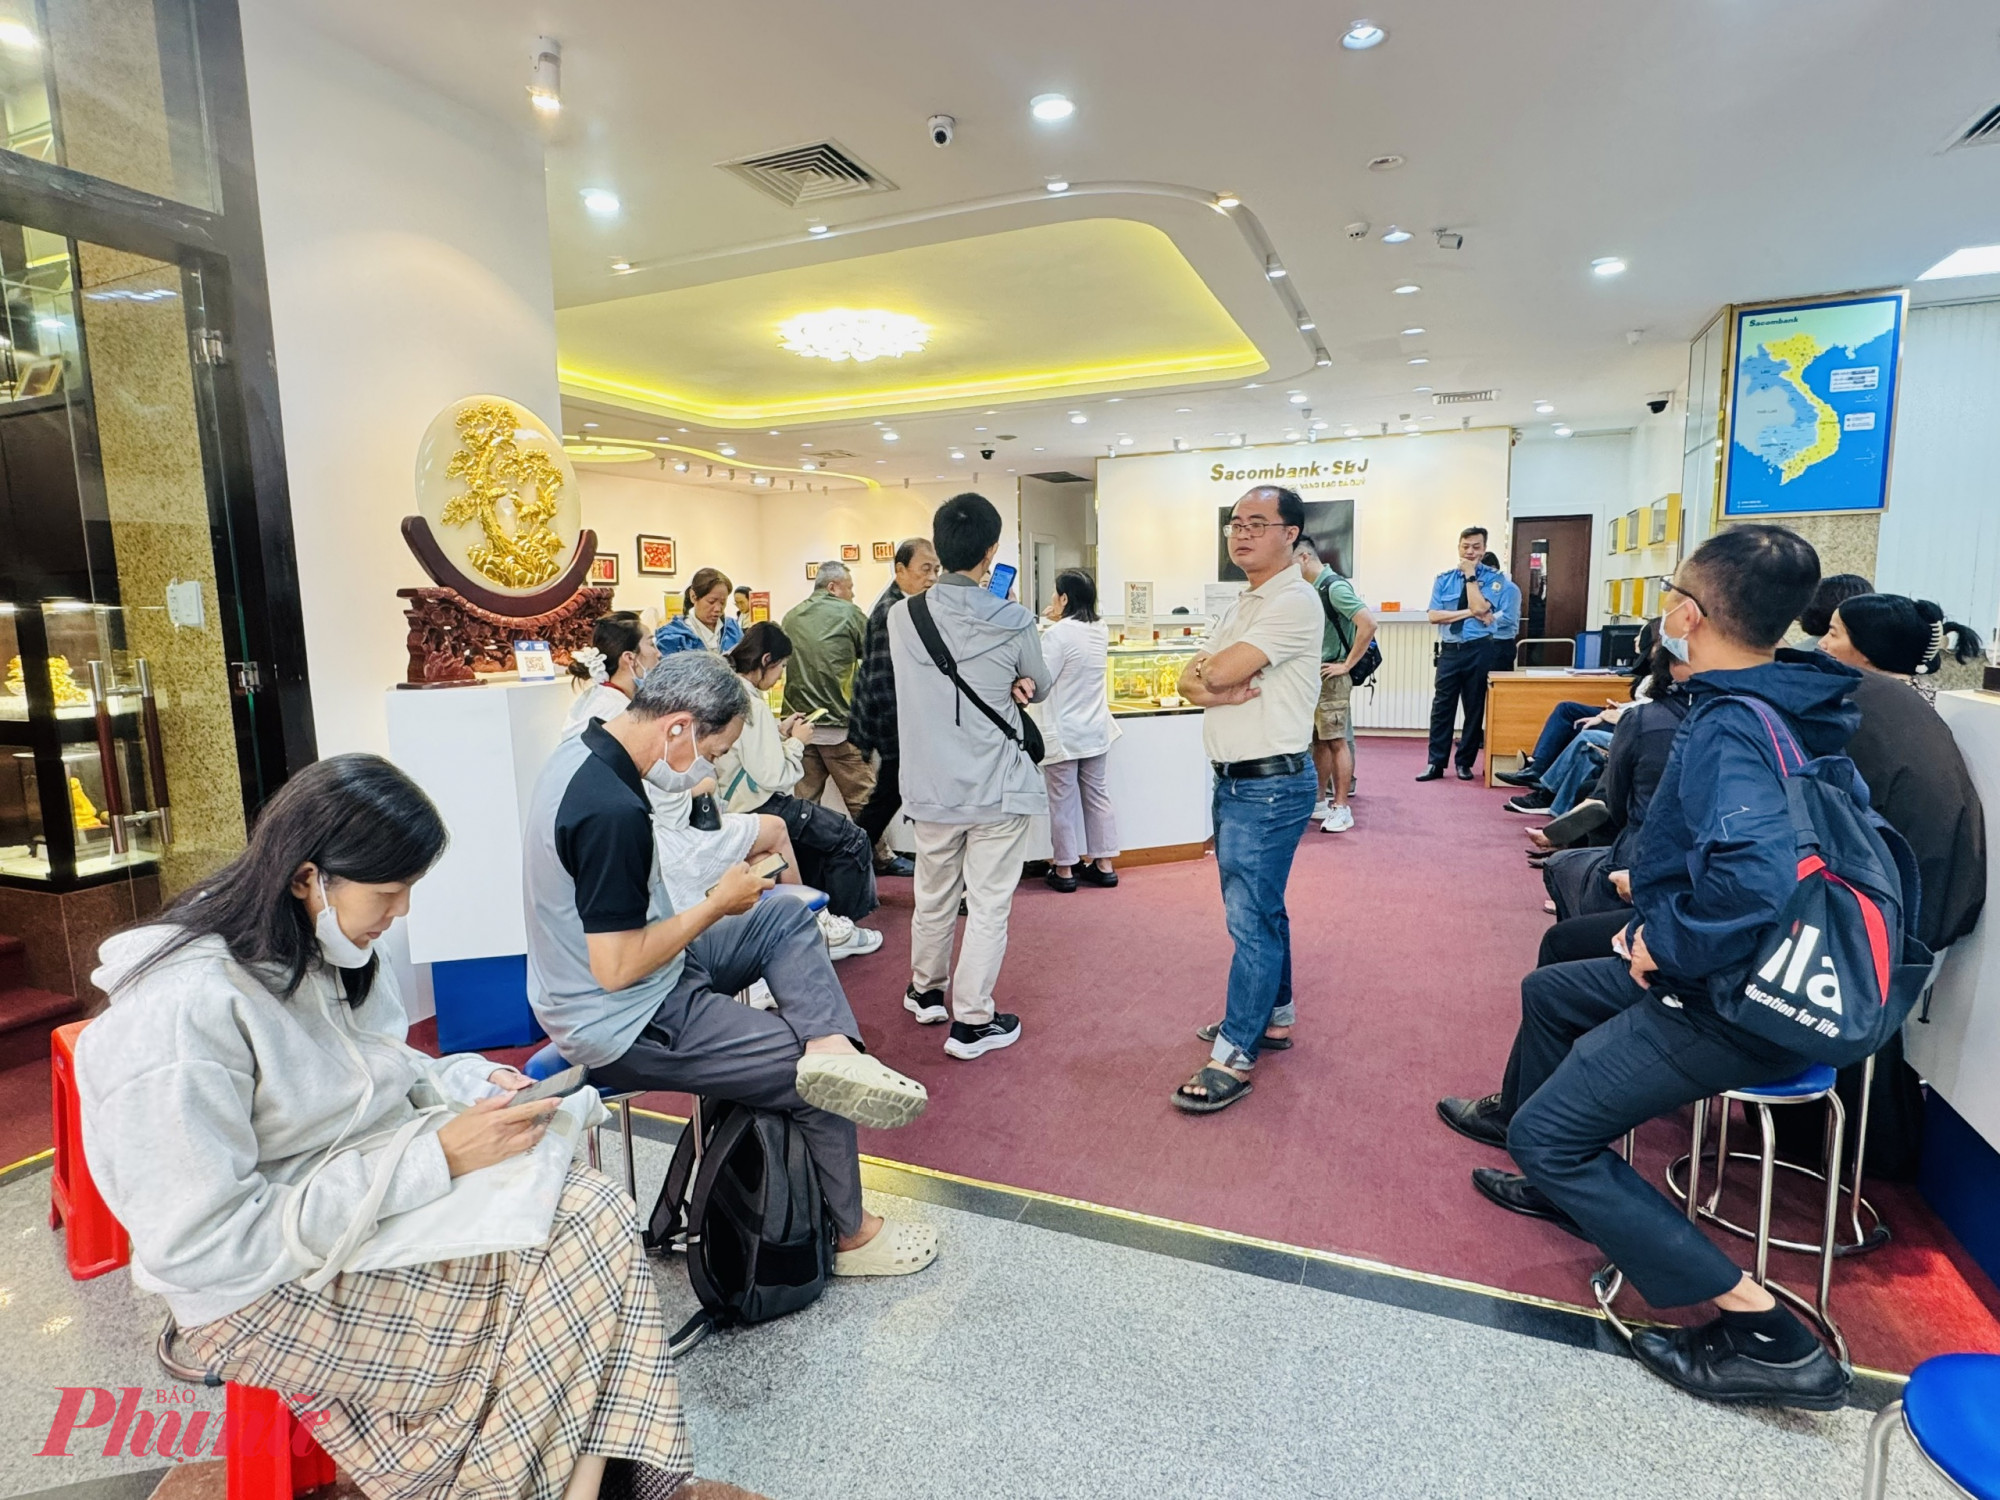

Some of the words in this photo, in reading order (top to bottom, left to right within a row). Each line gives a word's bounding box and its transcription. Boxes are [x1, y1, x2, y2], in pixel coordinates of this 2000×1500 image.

[1749, 316, 1798, 327] Sacombank
[1794, 1008, 1818, 1027] for
[1815, 1018, 1840, 1038] life
